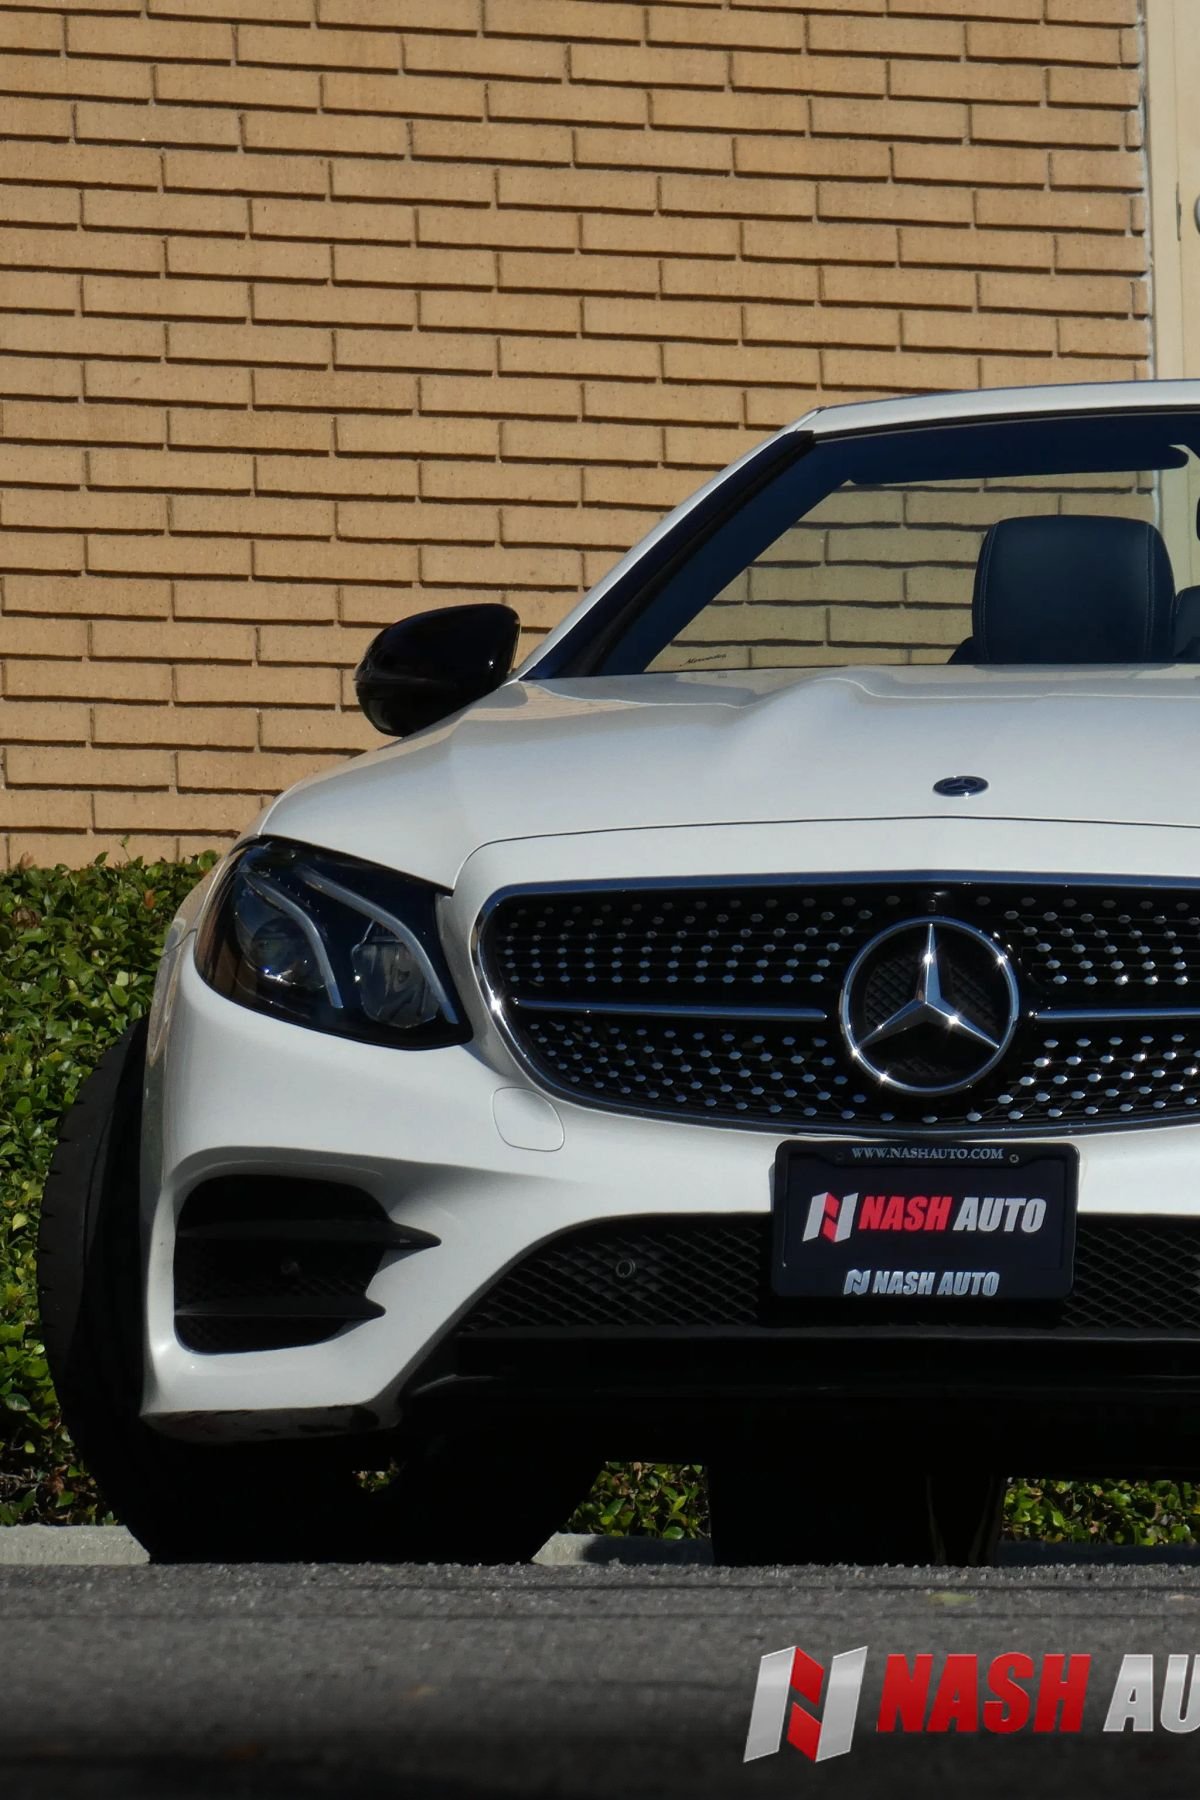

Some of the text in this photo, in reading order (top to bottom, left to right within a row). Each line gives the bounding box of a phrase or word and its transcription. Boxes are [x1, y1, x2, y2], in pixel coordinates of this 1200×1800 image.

[851, 1147, 1004, 1160] WWW.NASHAUTO.COM
[858, 1195, 953, 1231] NASH
[952, 1196, 1047, 1233] AUTO
[872, 1270, 935, 1296] NASH
[936, 1271, 1001, 1296] AUTO
